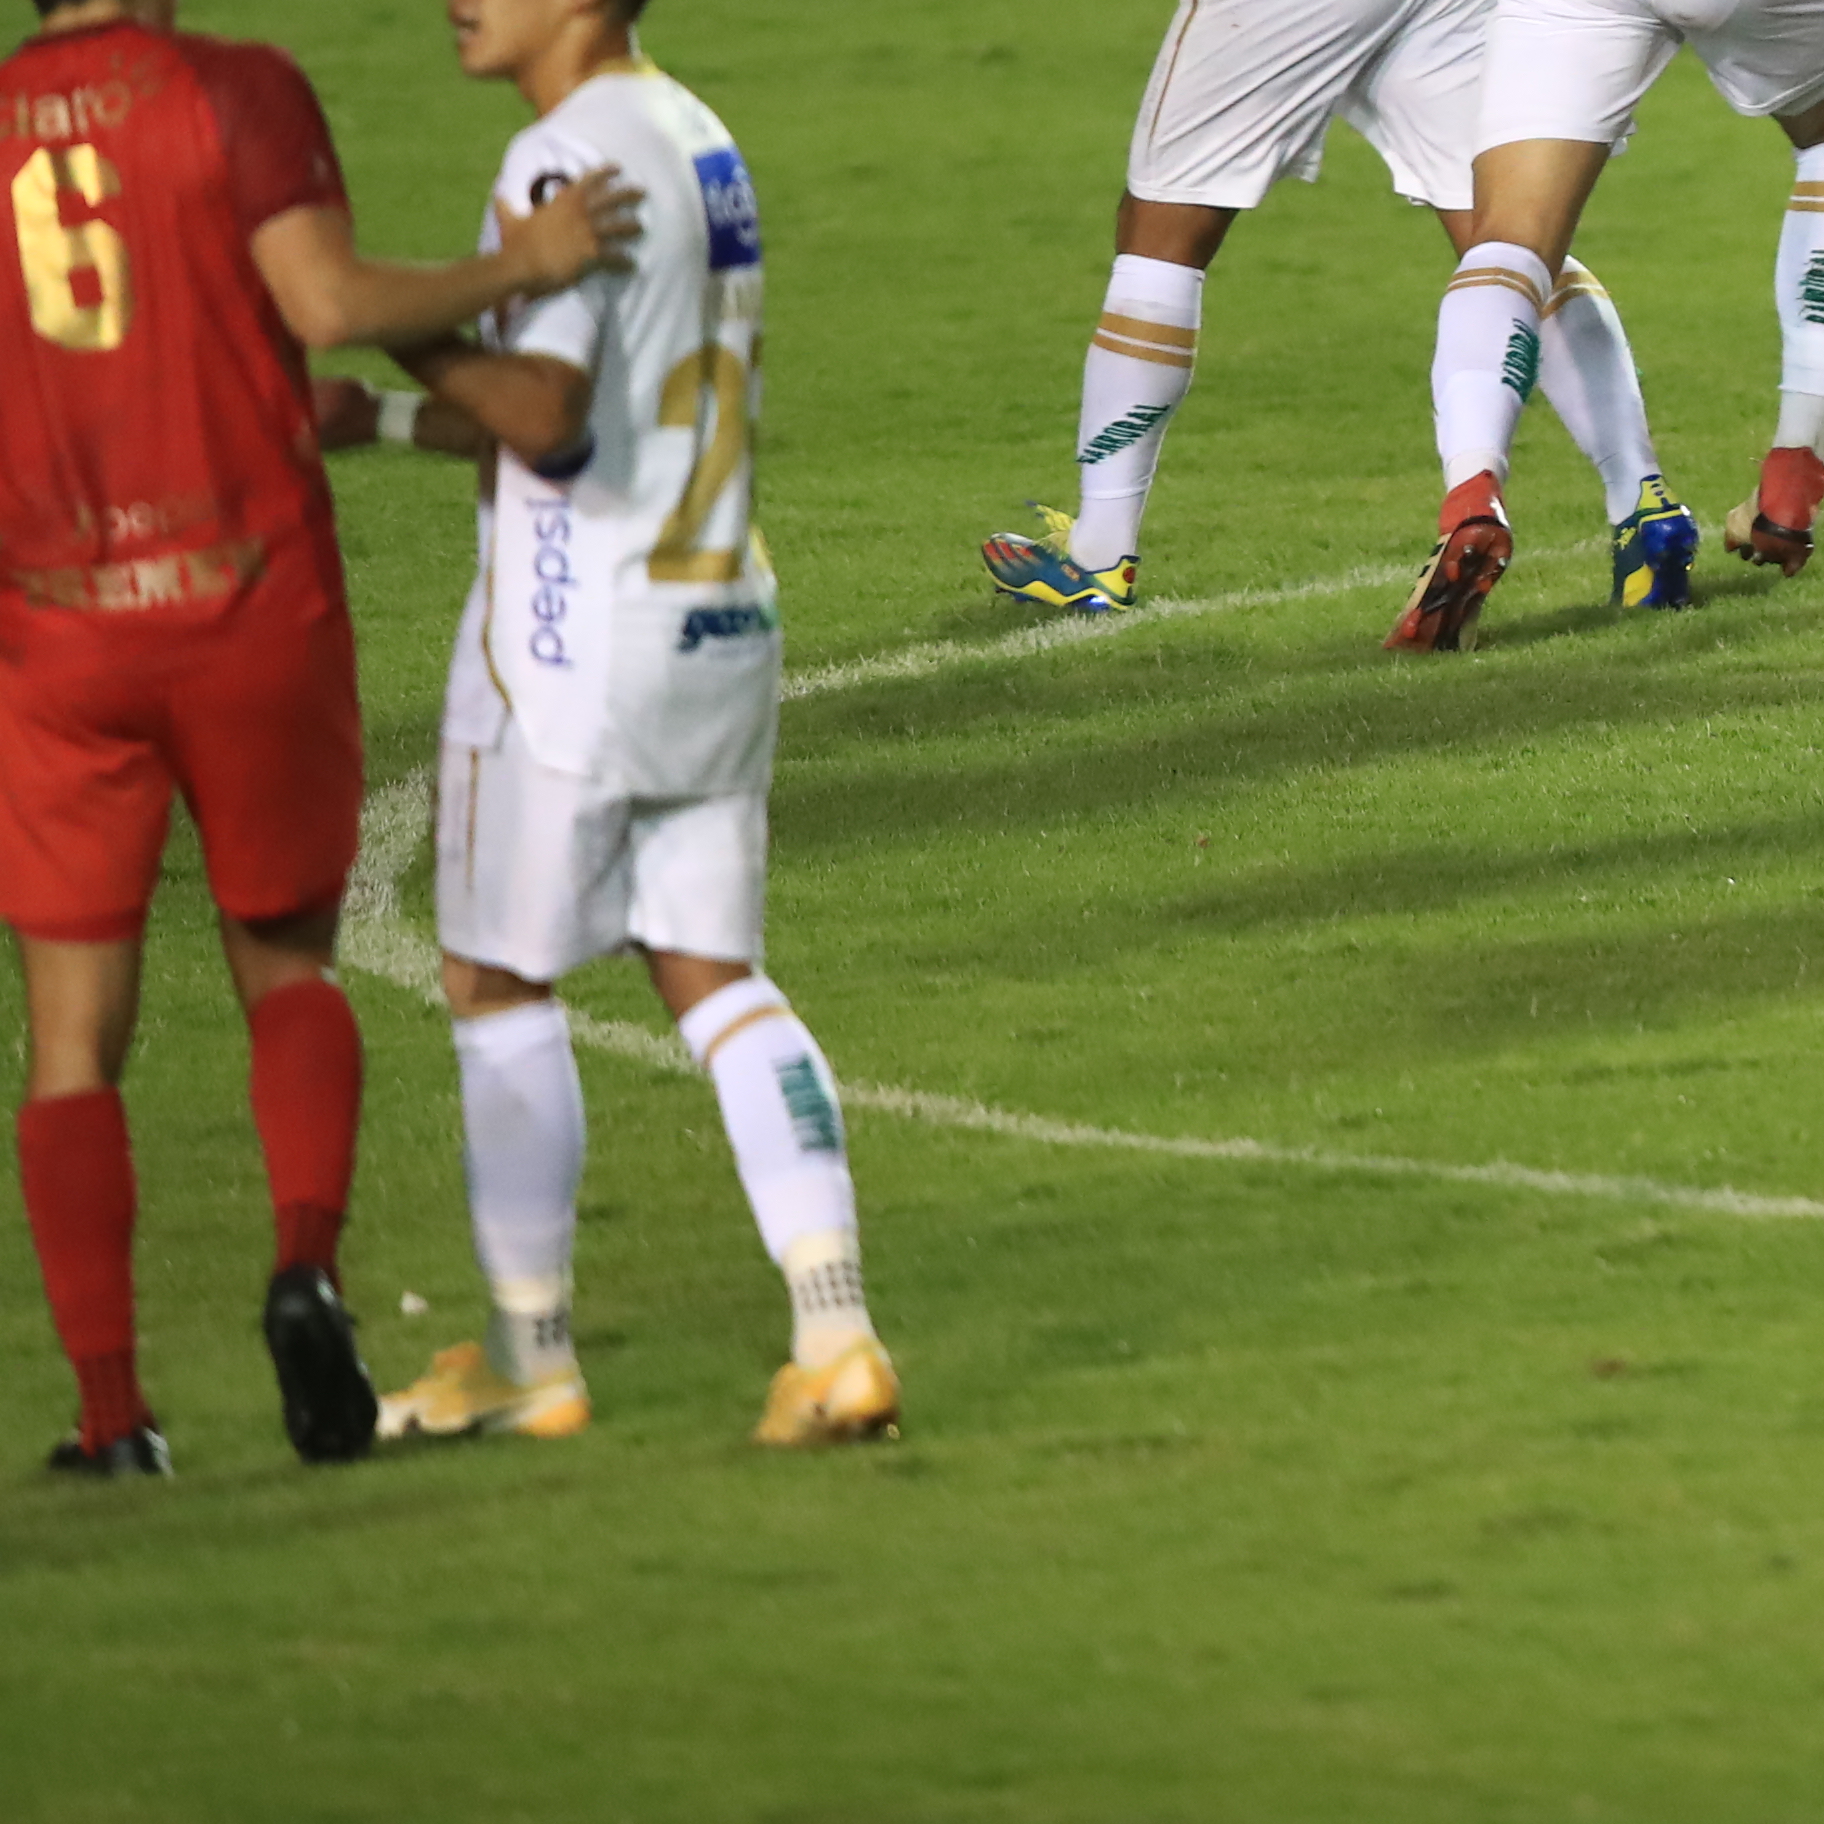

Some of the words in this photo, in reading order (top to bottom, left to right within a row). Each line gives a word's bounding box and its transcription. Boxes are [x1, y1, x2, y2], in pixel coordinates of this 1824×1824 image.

[0, 78, 133, 139] laro
[10, 141, 134, 351] 6
[530, 494, 572, 669] pepsi
